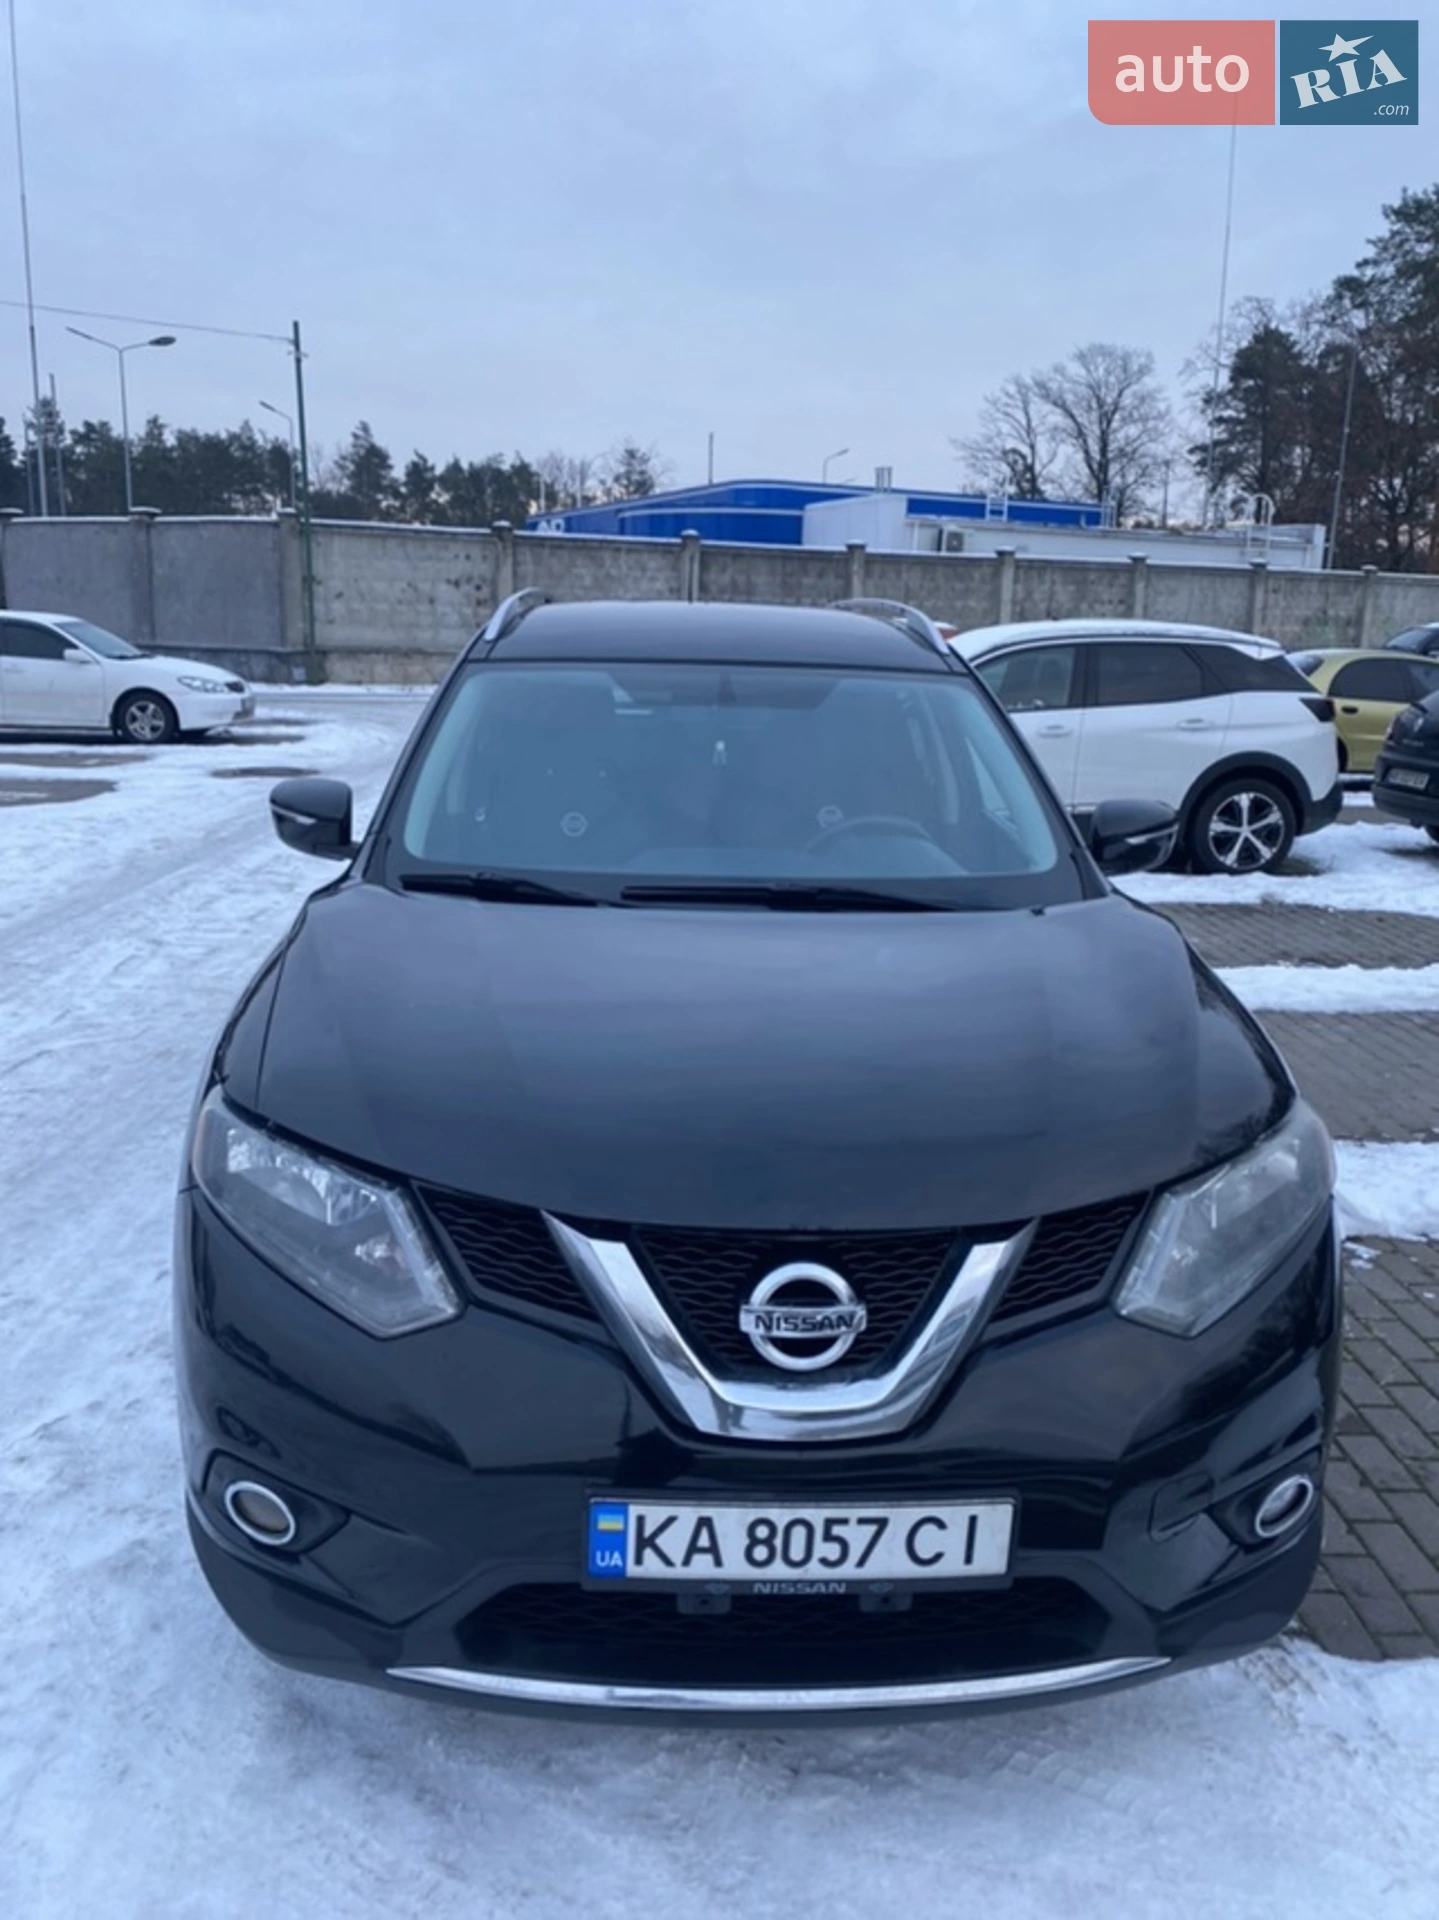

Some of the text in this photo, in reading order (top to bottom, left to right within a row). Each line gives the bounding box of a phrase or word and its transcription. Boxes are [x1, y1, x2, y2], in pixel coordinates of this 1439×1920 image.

[755, 1313, 852, 1332] NISSAN
[633, 1513, 979, 1570] KA 8057 CI
[596, 1550, 623, 1567] UA
[753, 1582, 846, 1594] NISSAN
